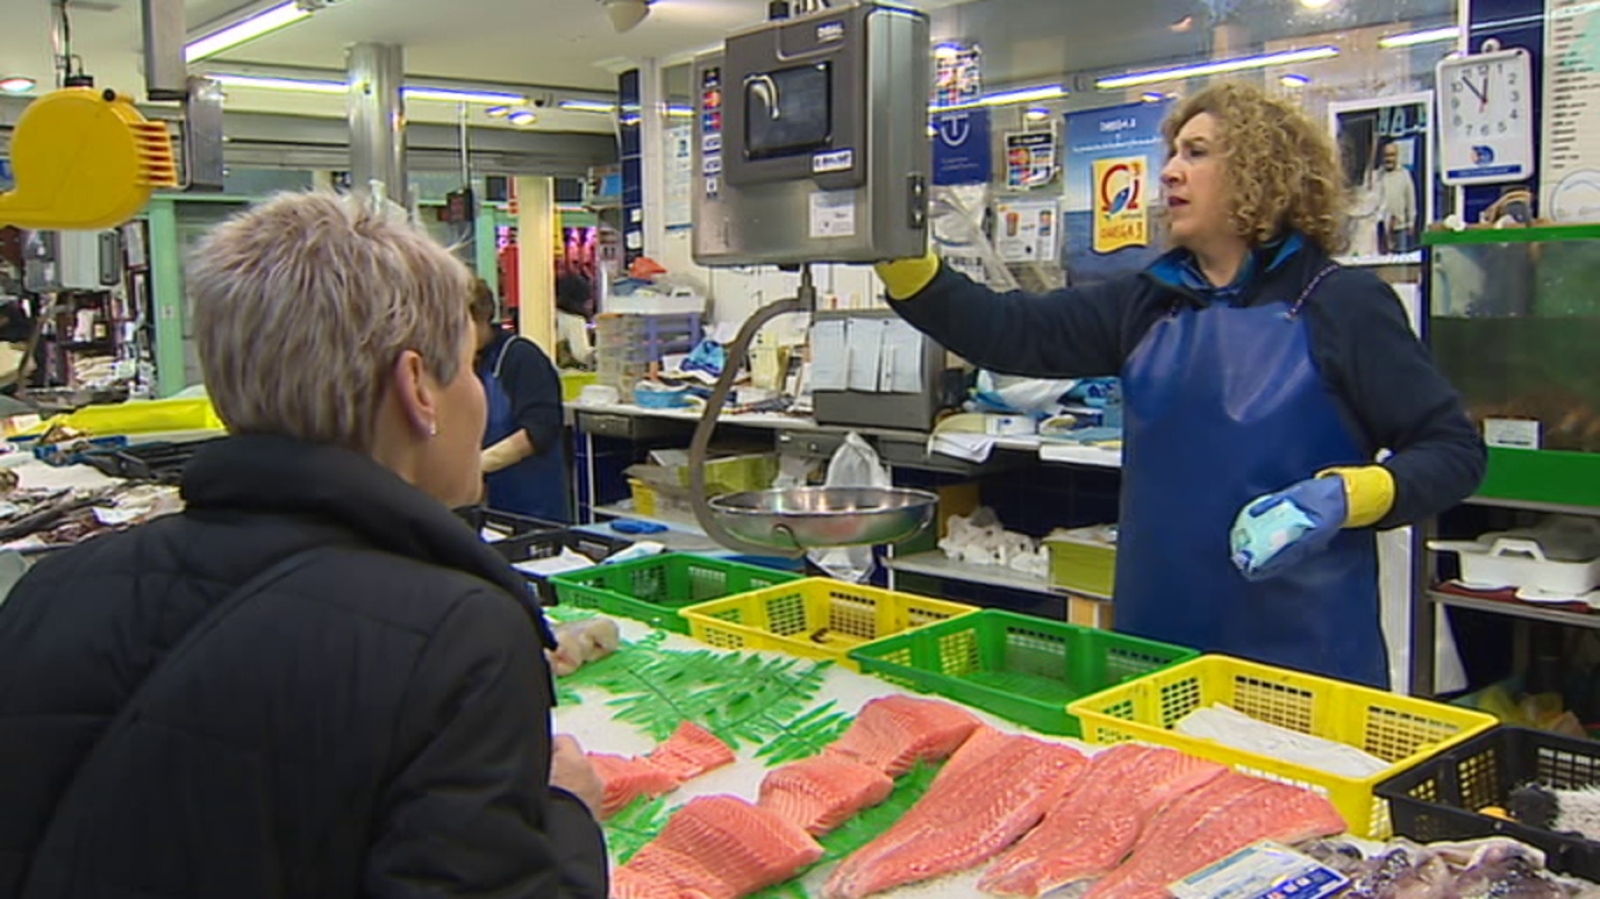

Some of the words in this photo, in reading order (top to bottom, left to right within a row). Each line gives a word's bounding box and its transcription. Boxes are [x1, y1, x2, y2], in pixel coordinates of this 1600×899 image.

[1477, 64, 1489, 75] 12
[1497, 63, 1503, 74] 1
[1508, 72, 1517, 84] 2
[1450, 82, 1463, 93] 10
[1510, 90, 1520, 102] 3
[1451, 97, 1460, 109] 9
[1509, 109, 1519, 119] 4
[1453, 115, 1462, 126] 8
[1466, 124, 1473, 135] 7
[1480, 124, 1489, 136] 6
[1498, 121, 1507, 133] 5
